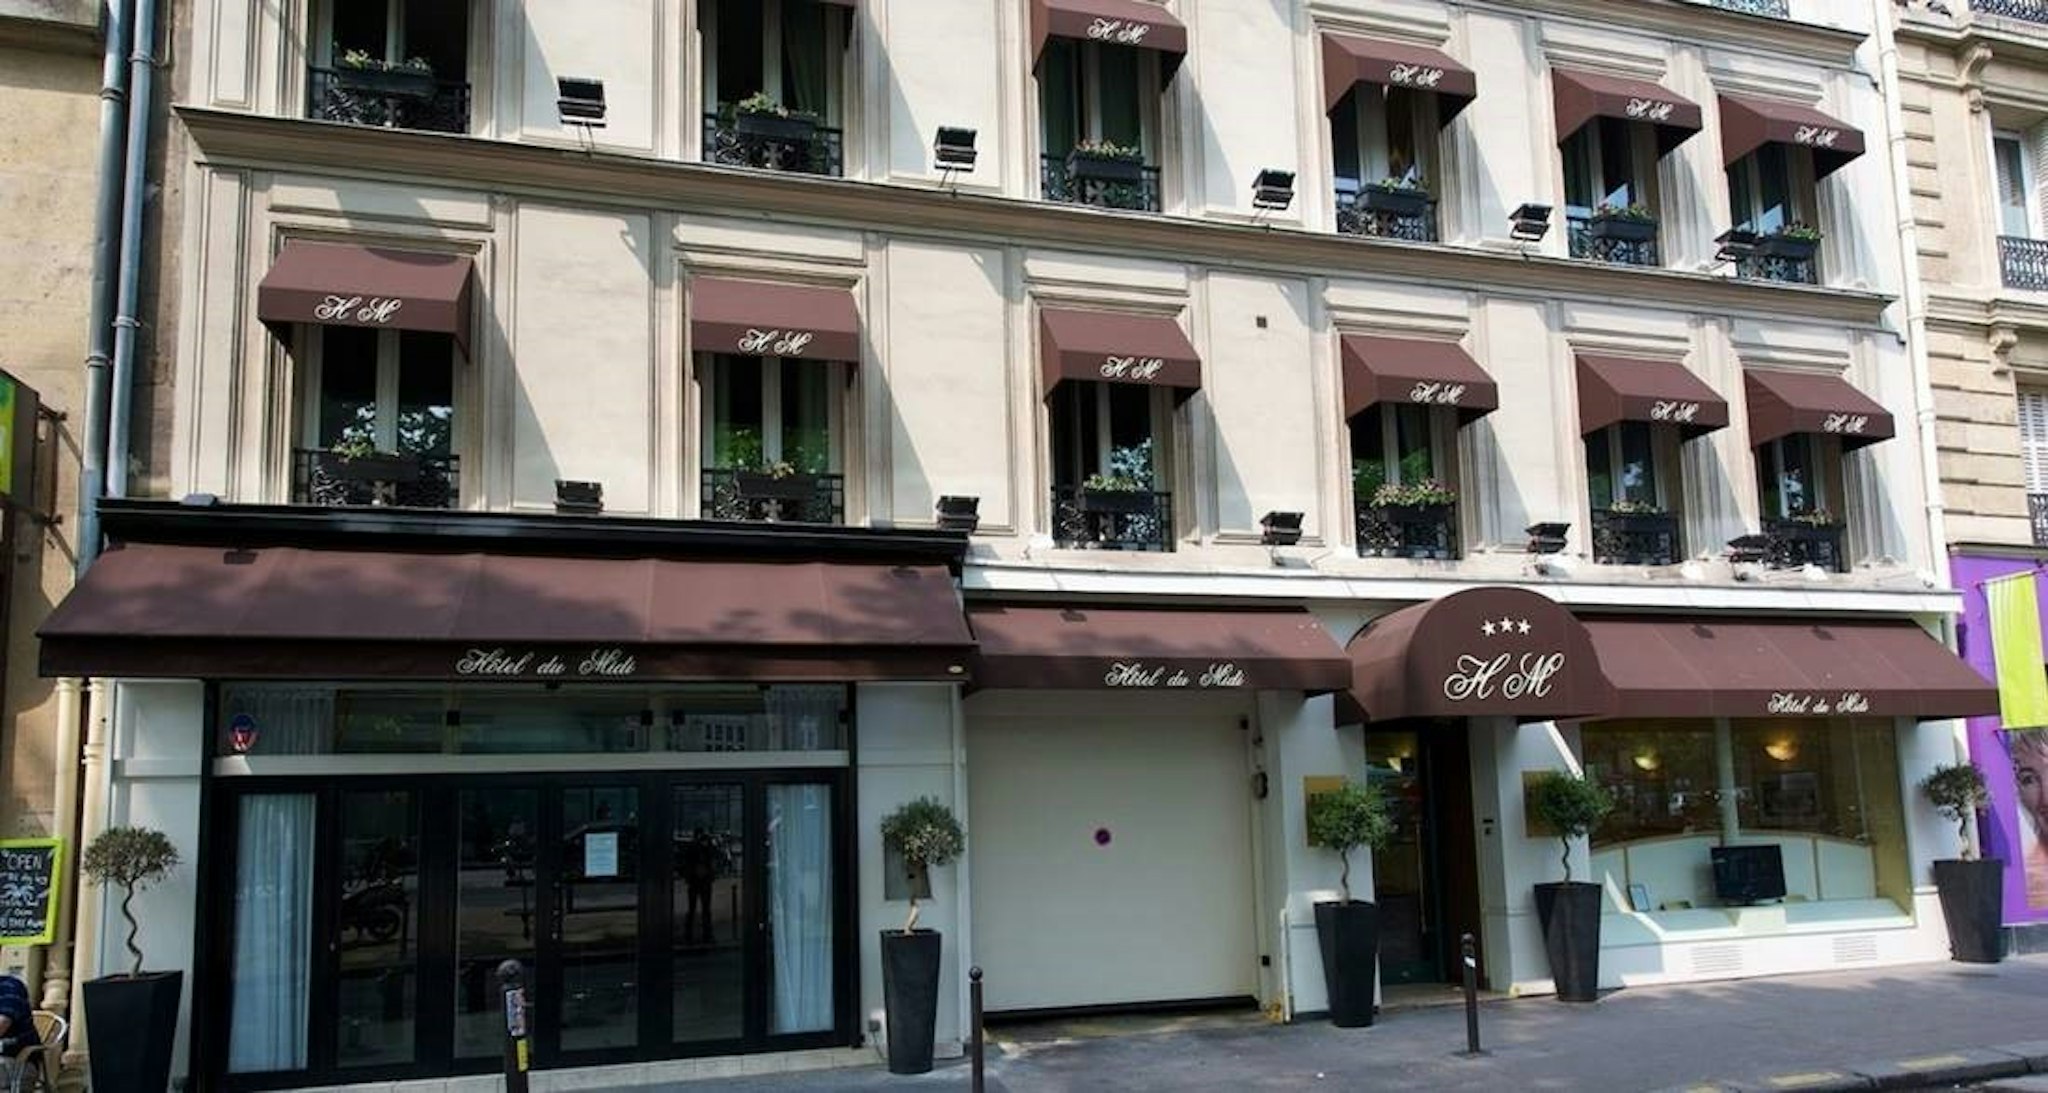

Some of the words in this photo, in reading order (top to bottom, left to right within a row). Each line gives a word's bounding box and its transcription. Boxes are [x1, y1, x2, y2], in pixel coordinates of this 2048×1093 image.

[456, 648, 534, 675] Hôtel
[536, 655, 567, 675] du
[578, 649, 636, 676] Midi
[1104, 662, 1165, 687] Hôtel
[1166, 669, 1190, 687] du
[1443, 652, 1511, 700] H
[1503, 652, 1565, 700] M
[1812, 698, 1830, 714] du
